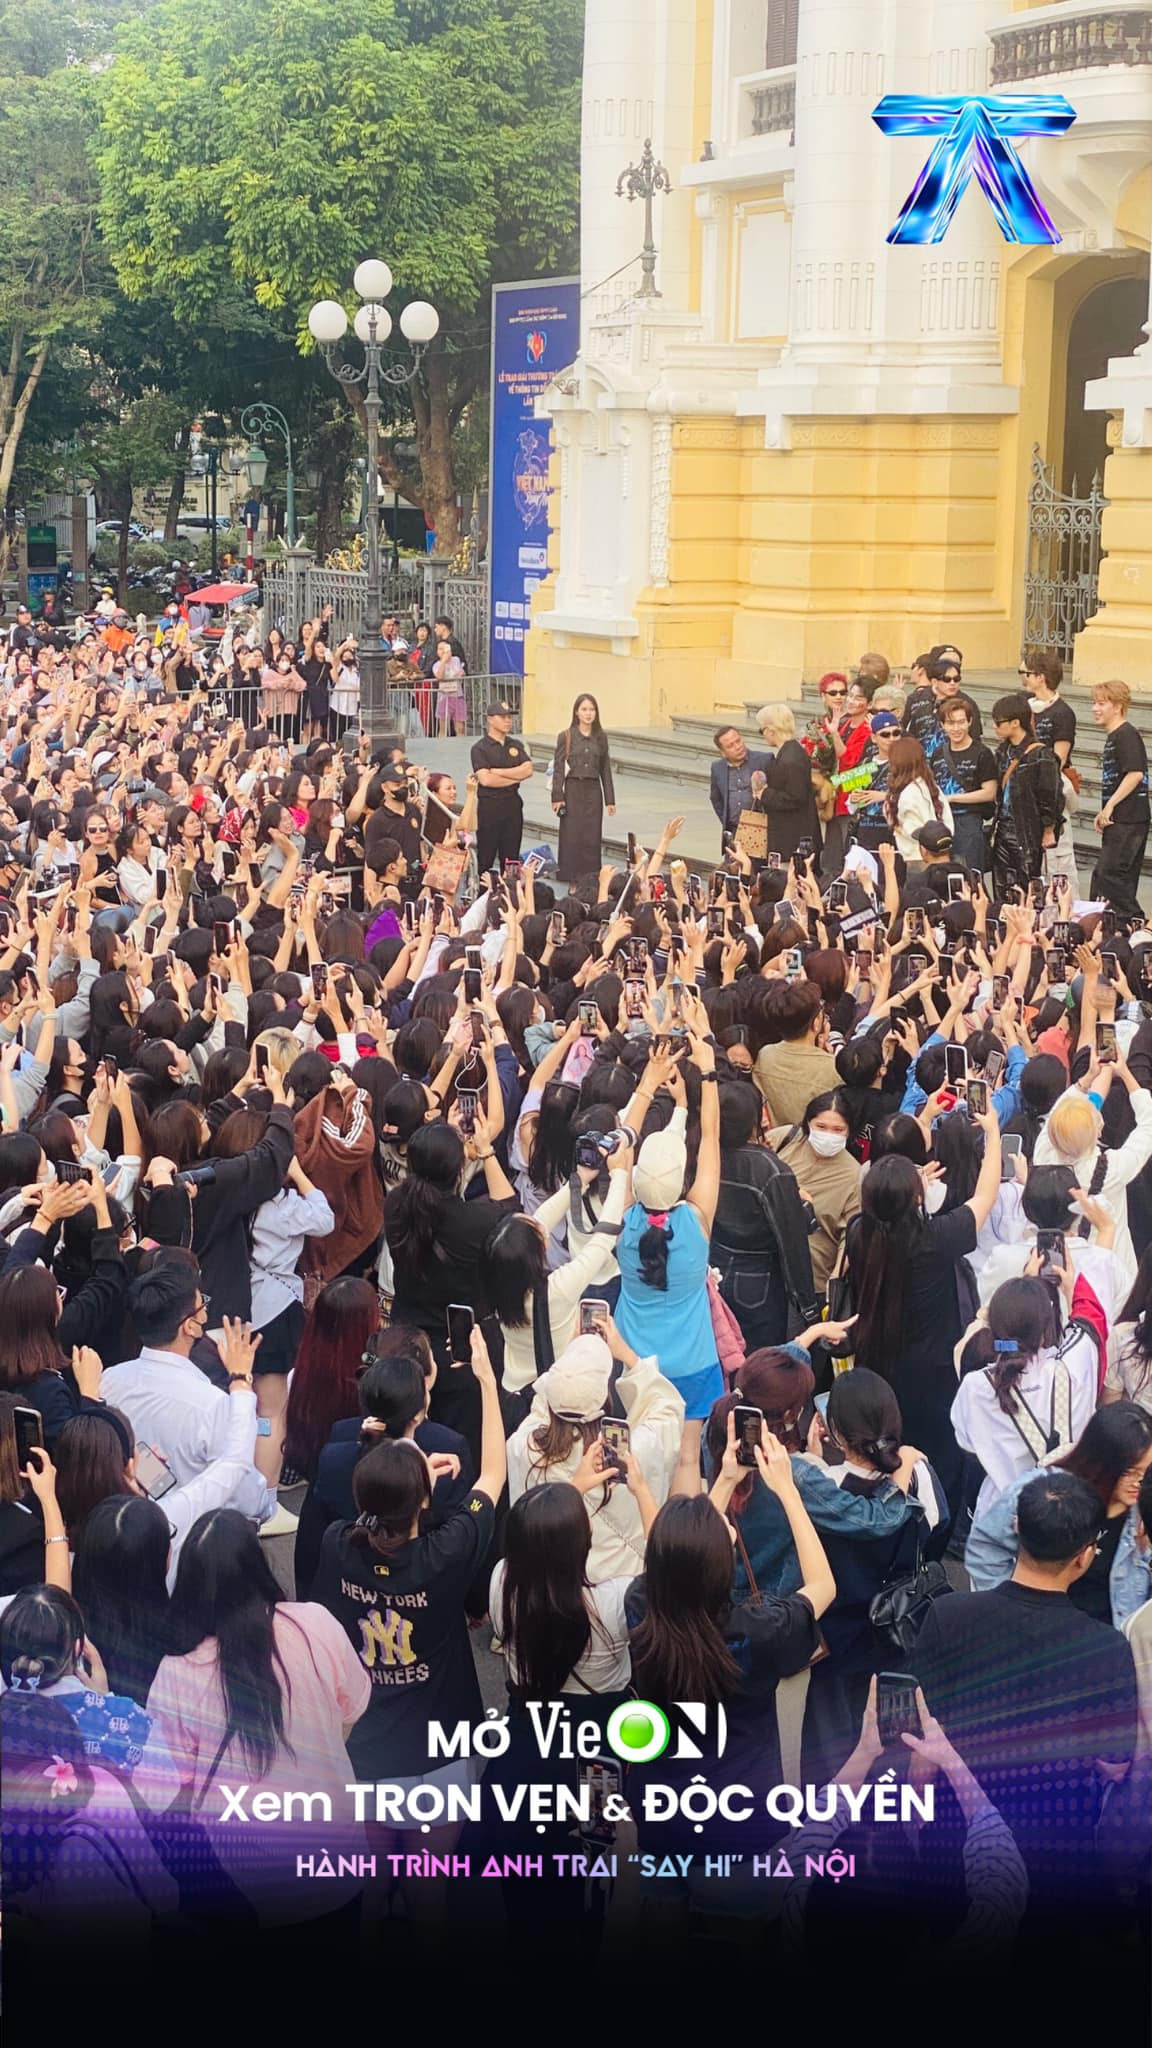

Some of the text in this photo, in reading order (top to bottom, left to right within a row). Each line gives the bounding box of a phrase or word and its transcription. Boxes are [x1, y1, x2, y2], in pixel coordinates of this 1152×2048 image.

[341, 1577, 428, 1607] NEW YORK
[370, 1663, 430, 1685] NKEES
